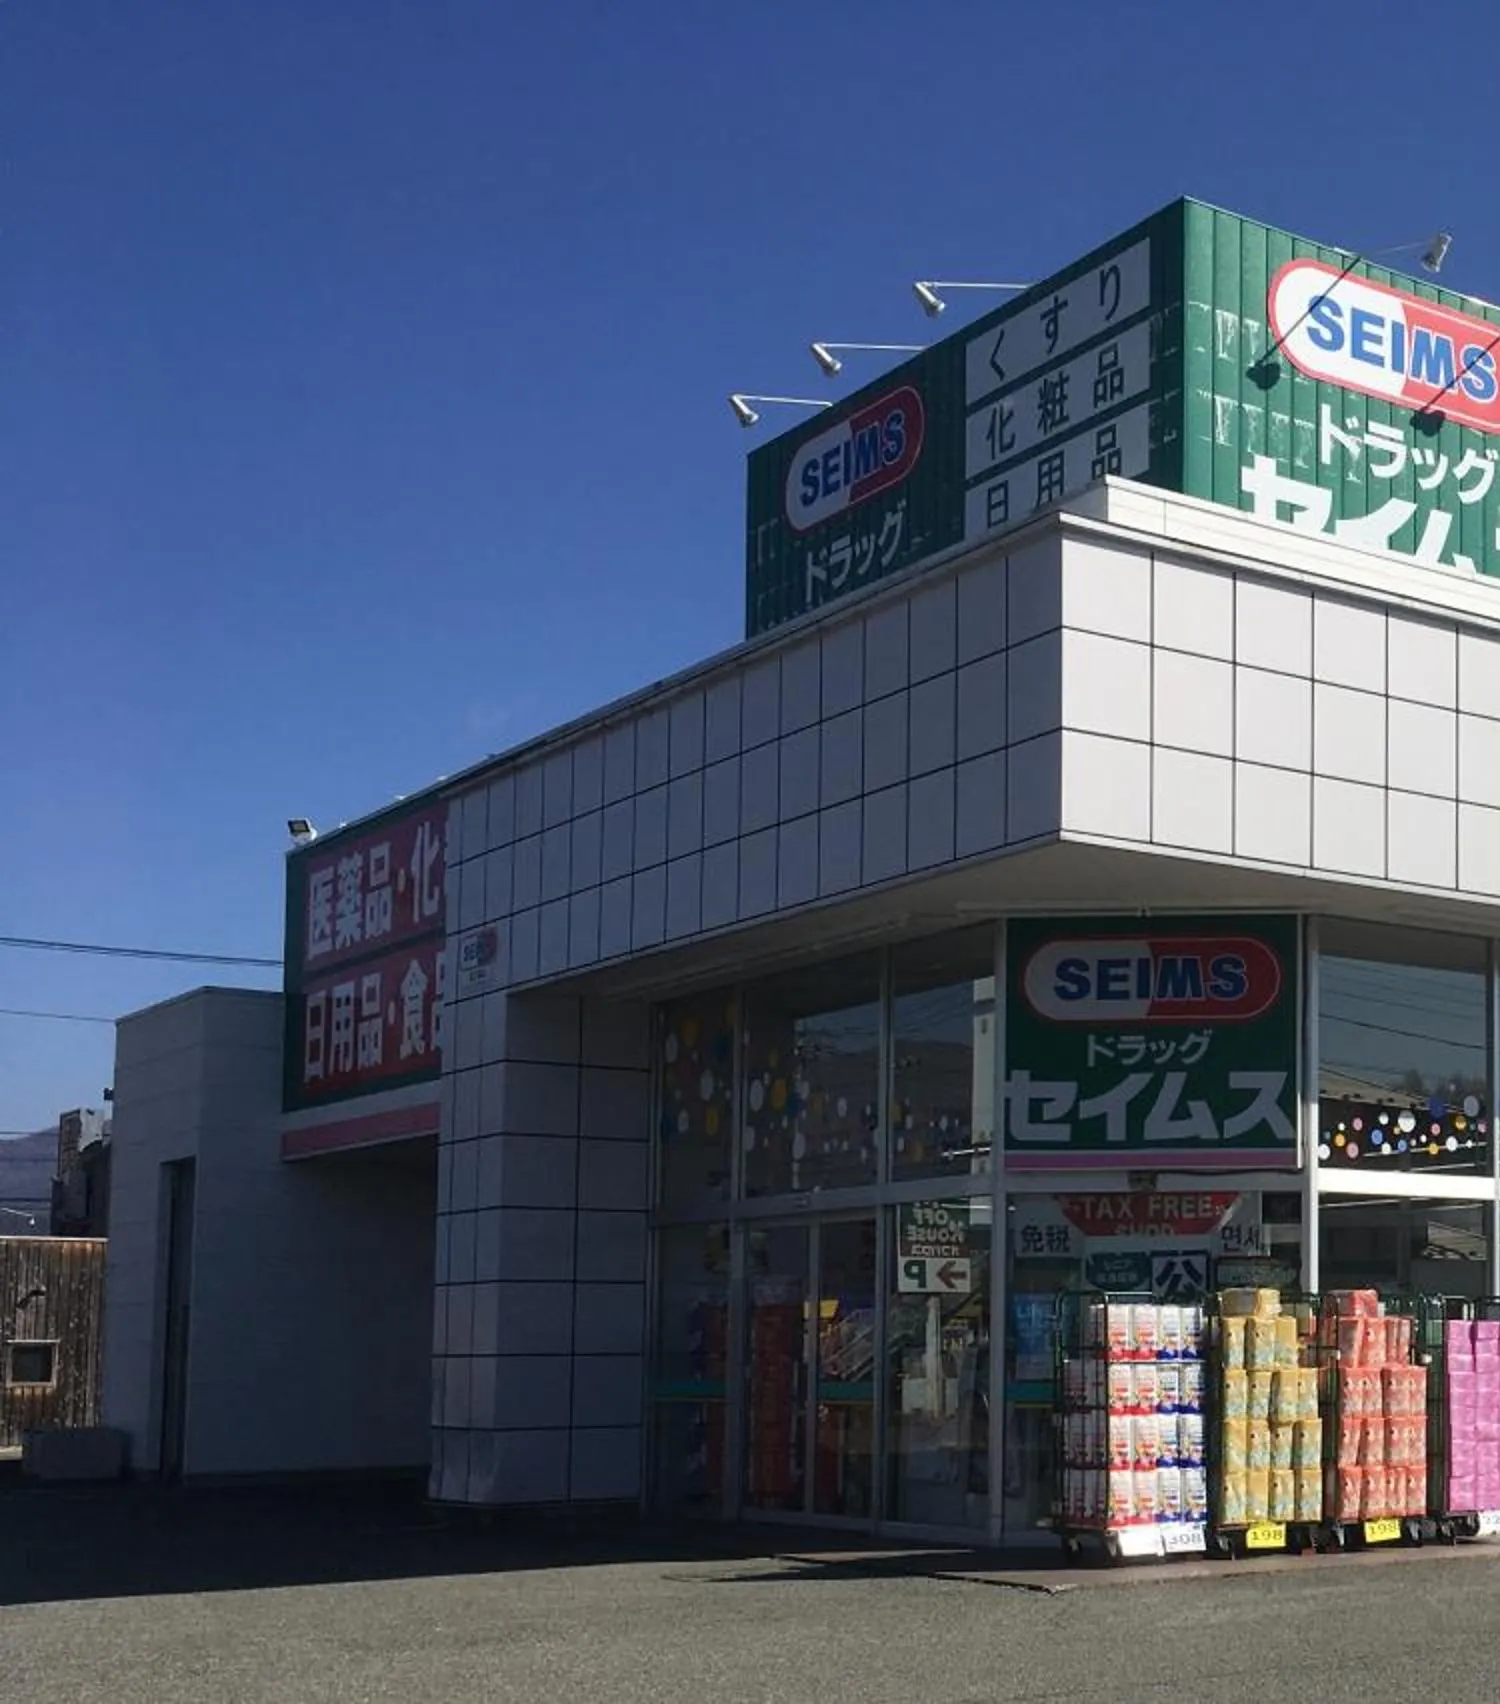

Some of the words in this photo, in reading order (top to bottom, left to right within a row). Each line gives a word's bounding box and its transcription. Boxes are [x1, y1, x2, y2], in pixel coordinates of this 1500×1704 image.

[990, 264, 1121, 380] くすり
[1305, 294, 1499, 403] SEIMS
[986, 342, 1125, 460] 化粧品
[800, 410, 905, 508] SEIMS
[987, 430, 1122, 529] 日用品
[1319, 403, 1500, 504] ドラッグ
[806, 500, 908, 604] ドラッグ
[309, 821, 447, 958] 医薬品・化
[305, 952, 441, 1081] 日用品・食
[1053, 955, 1249, 1001] SEIMS
[1087, 1029, 1213, 1068] ドラッグ
[1003, 1069, 1298, 1141] セイムス
[1020, 1224, 1071, 1253] 免税
[1080, 1195, 1135, 1220] TAX
[1148, 1195, 1214, 1219] FREE
[1251, 1528, 1283, 1542] 198
[1367, 1520, 1398, 1536] 198
